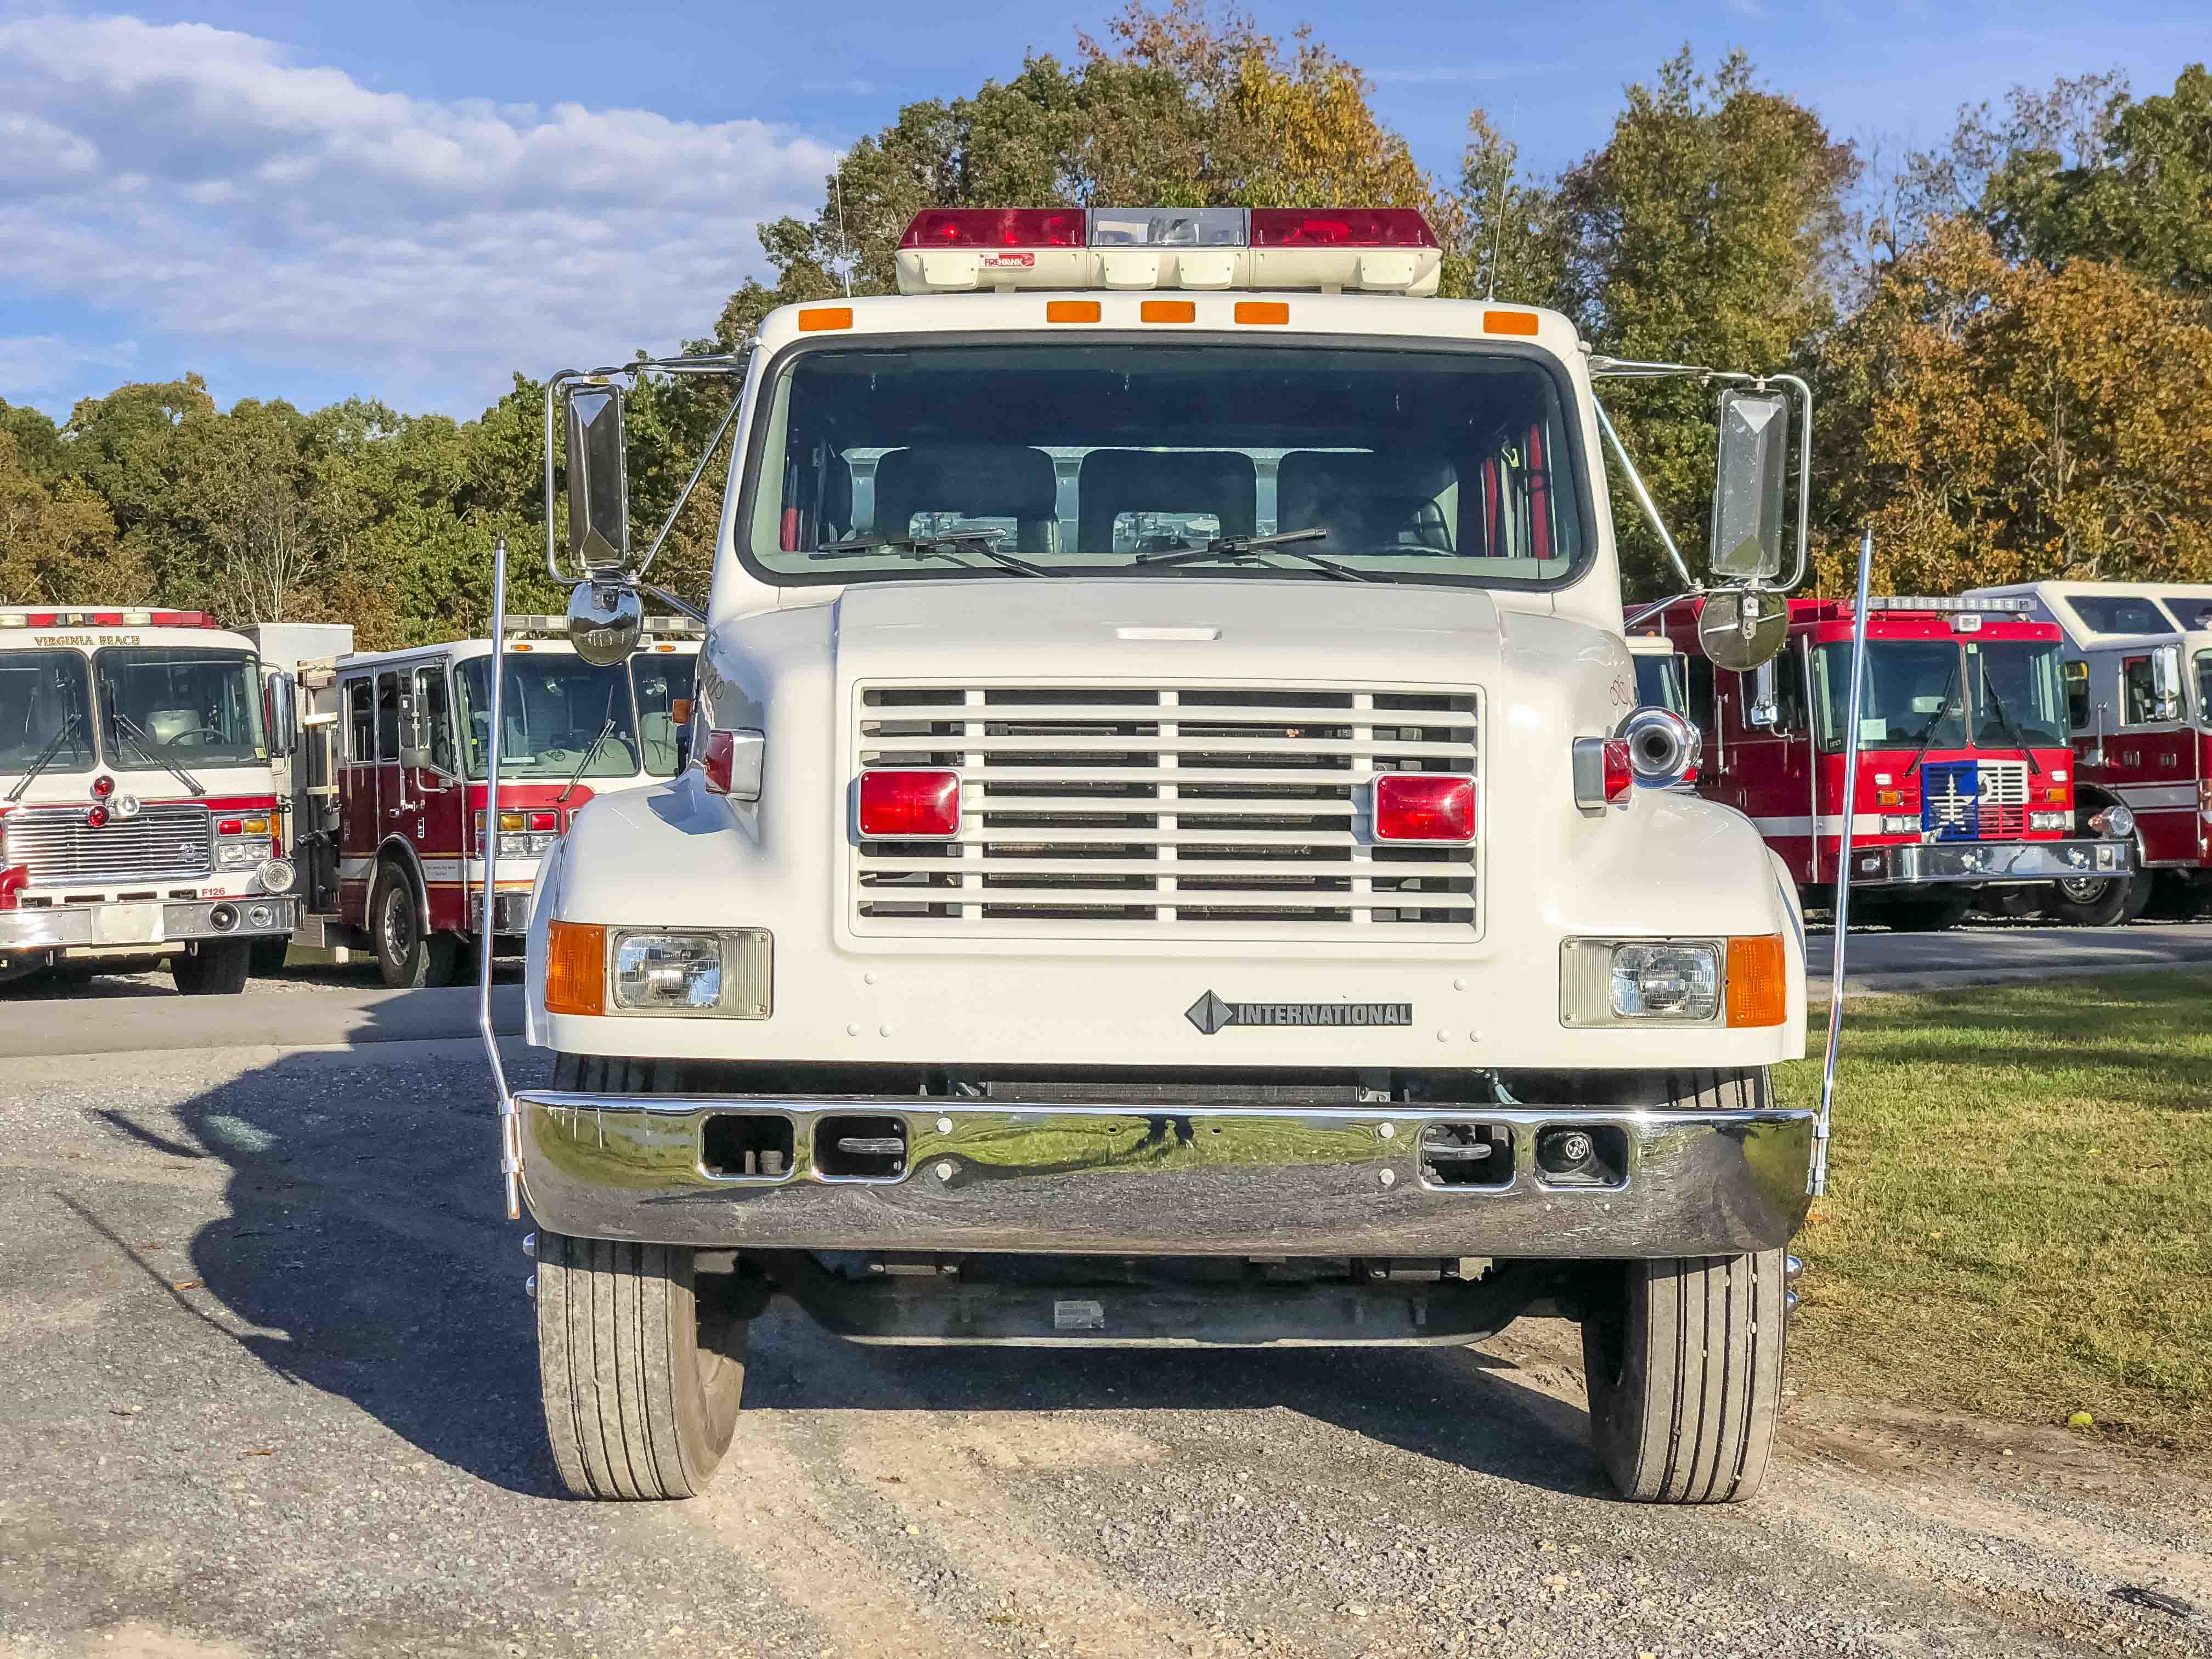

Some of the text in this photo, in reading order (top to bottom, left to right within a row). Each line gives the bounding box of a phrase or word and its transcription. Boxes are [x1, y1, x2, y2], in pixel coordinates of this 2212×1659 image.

[33, 635, 141, 646] VIRGINIA BEACH
[201, 887, 225, 896] F126
[1237, 1004, 1410, 1025] INTERNATIONAL
